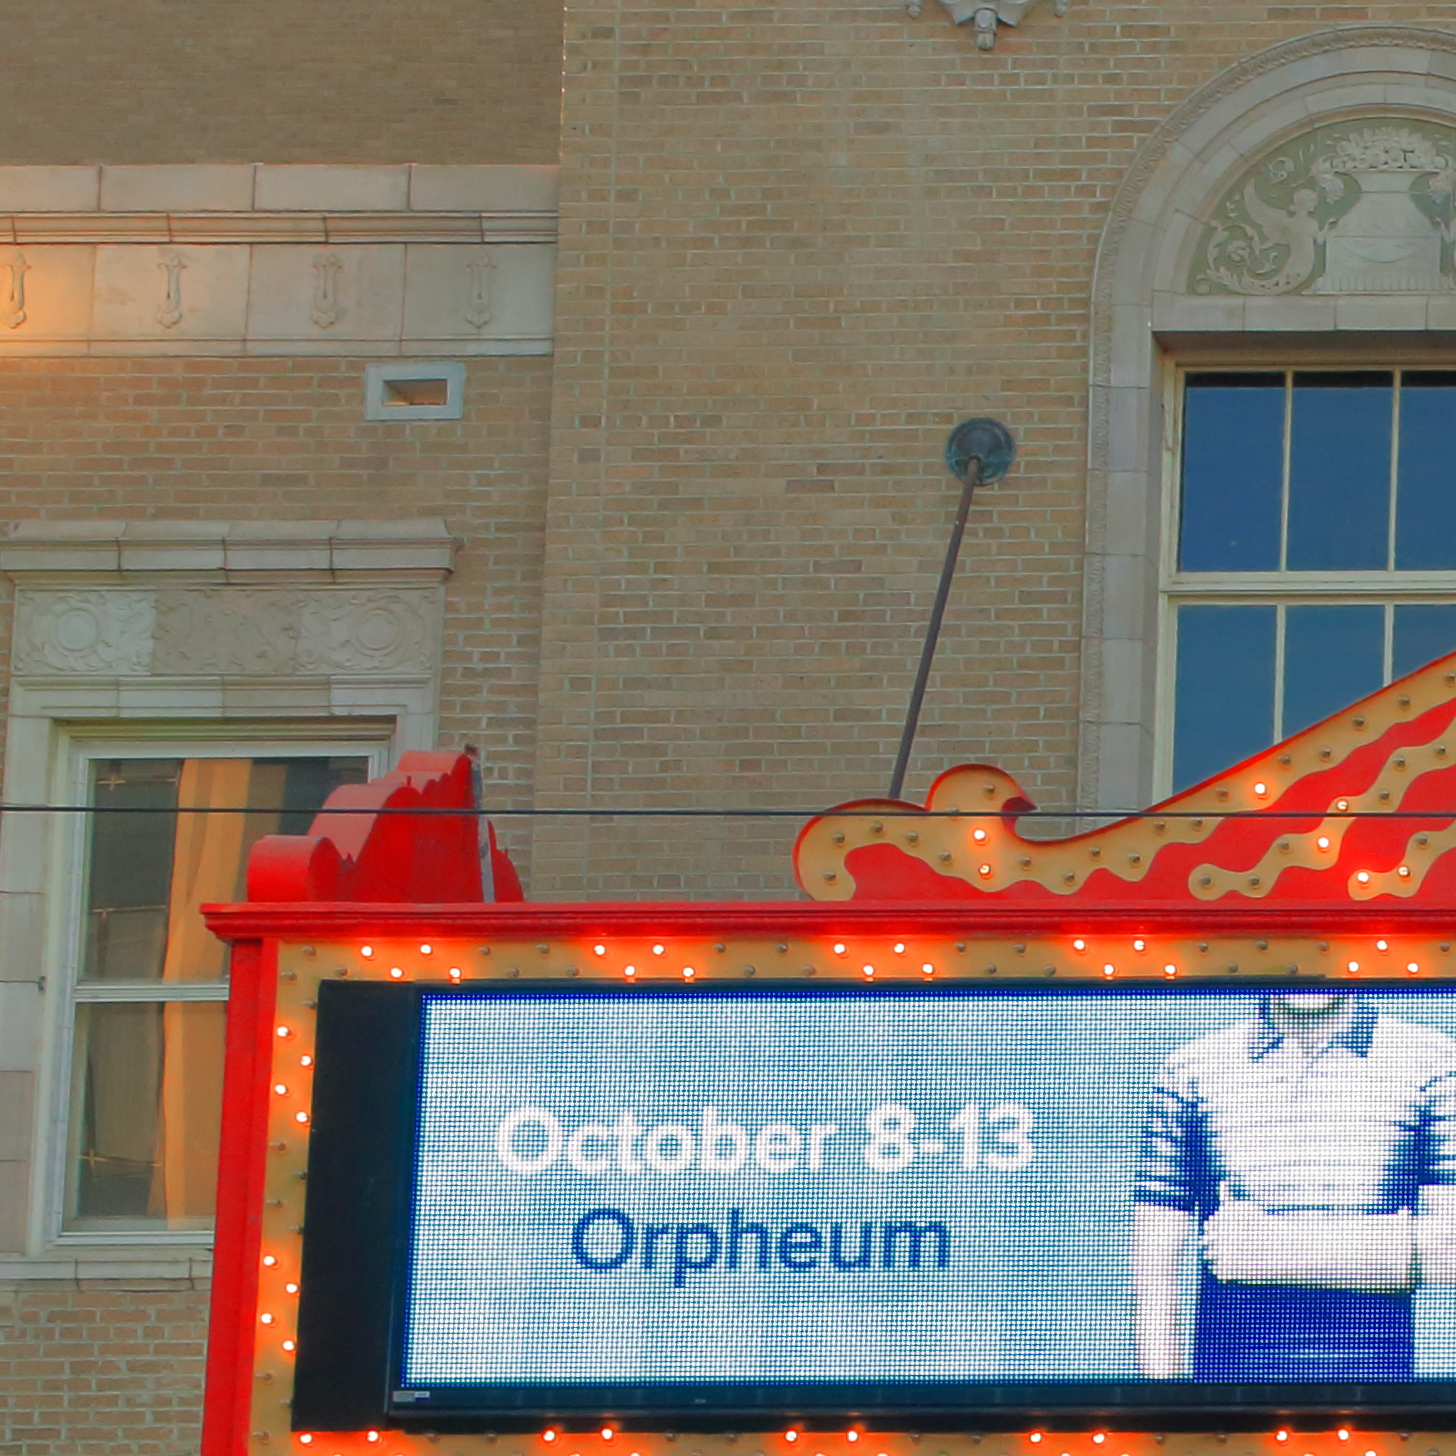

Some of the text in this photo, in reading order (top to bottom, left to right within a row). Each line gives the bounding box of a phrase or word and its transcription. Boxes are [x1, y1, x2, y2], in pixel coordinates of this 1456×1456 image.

[493, 1101, 1034, 1177] October 8-13
[571, 1210, 950, 1287] Orpheum
